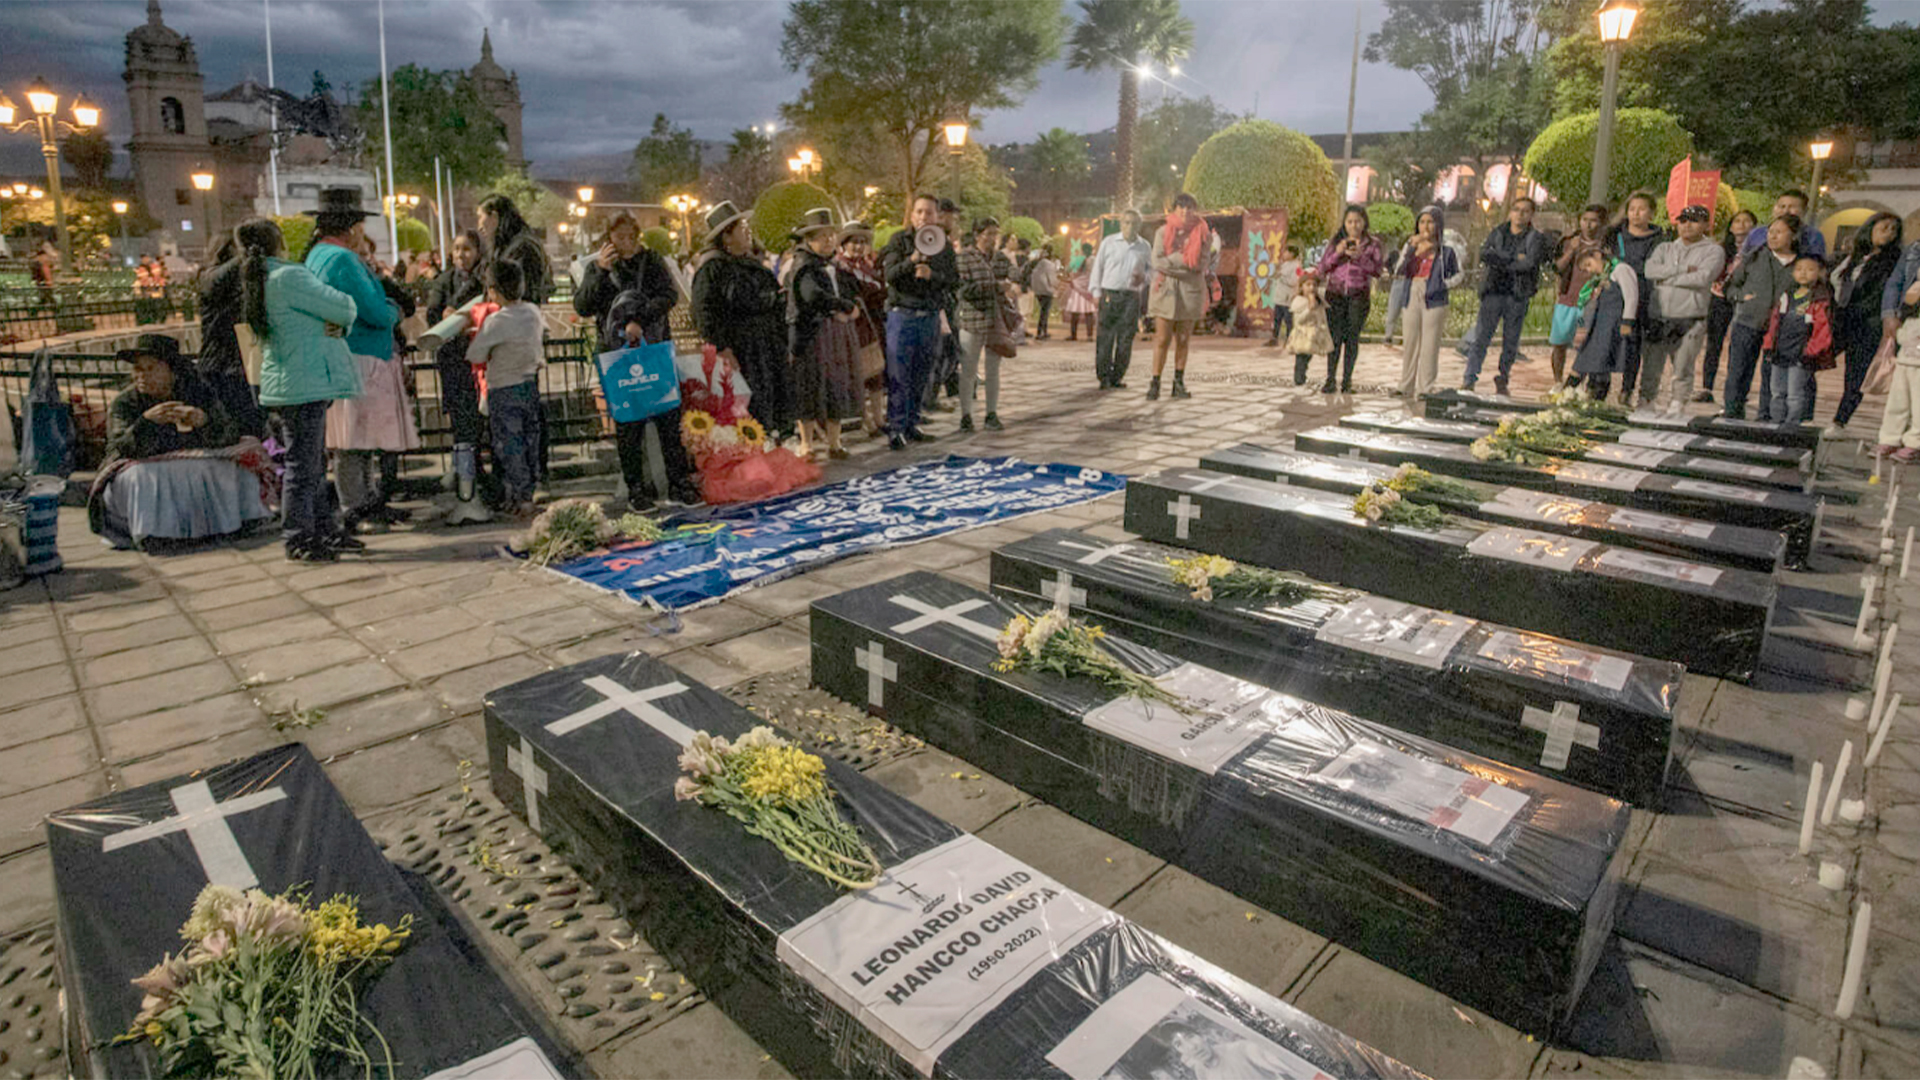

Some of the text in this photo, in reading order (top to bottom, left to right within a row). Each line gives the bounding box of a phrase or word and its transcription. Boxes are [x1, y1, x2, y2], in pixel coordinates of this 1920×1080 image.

[851, 870, 1032, 987] LEONARDO DAVID
[884, 886, 1060, 1005] HANCCO CHACCA
[967, 926, 1042, 982] (1990-2022)
